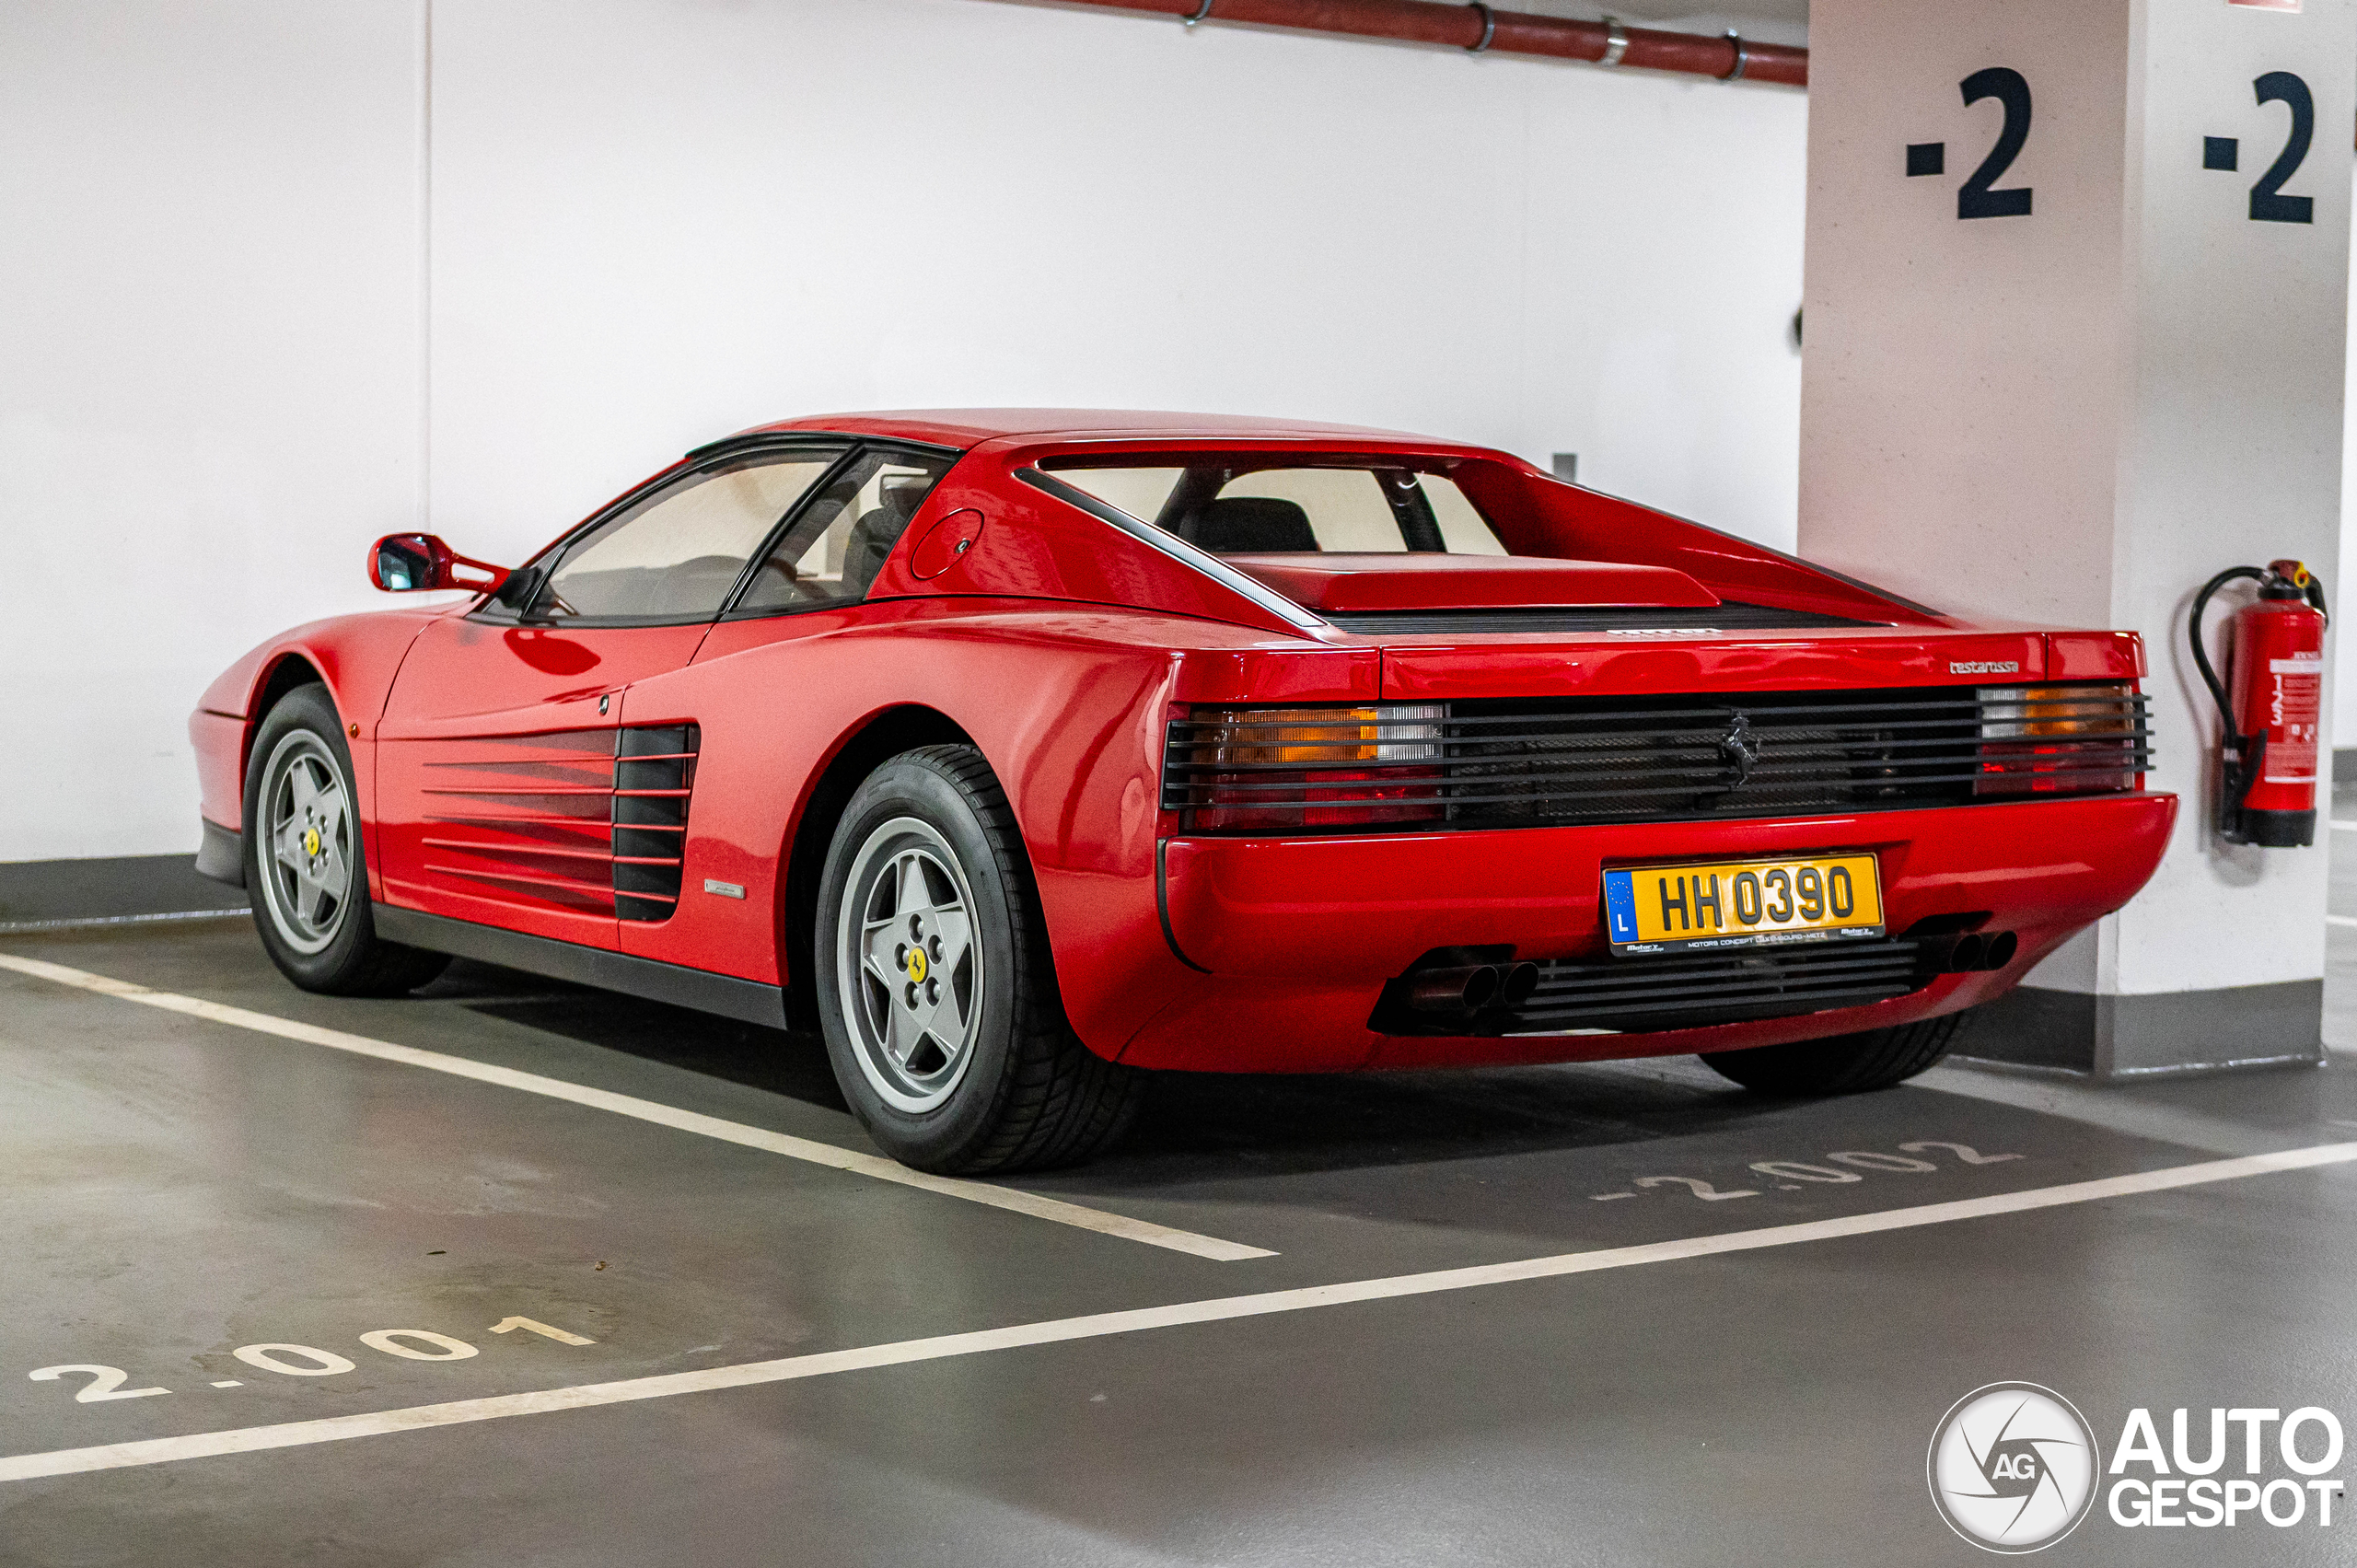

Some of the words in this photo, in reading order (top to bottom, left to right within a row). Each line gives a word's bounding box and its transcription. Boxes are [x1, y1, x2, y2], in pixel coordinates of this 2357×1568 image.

[1906, 66, 2033, 220] -2
[2202, 71, 2315, 224] -2
[2273, 673, 2282, 691] 1
[2271, 691, 2283, 708] 2
[2270, 708, 2282, 726] 3
[1659, 874, 1723, 932] HH
[1734, 865, 1854, 924] 0390
[1618, 913, 1629, 932] L
[1688, 939, 1718, 948] MOTORS
[1720, 936, 1754, 946] CONCEPT
